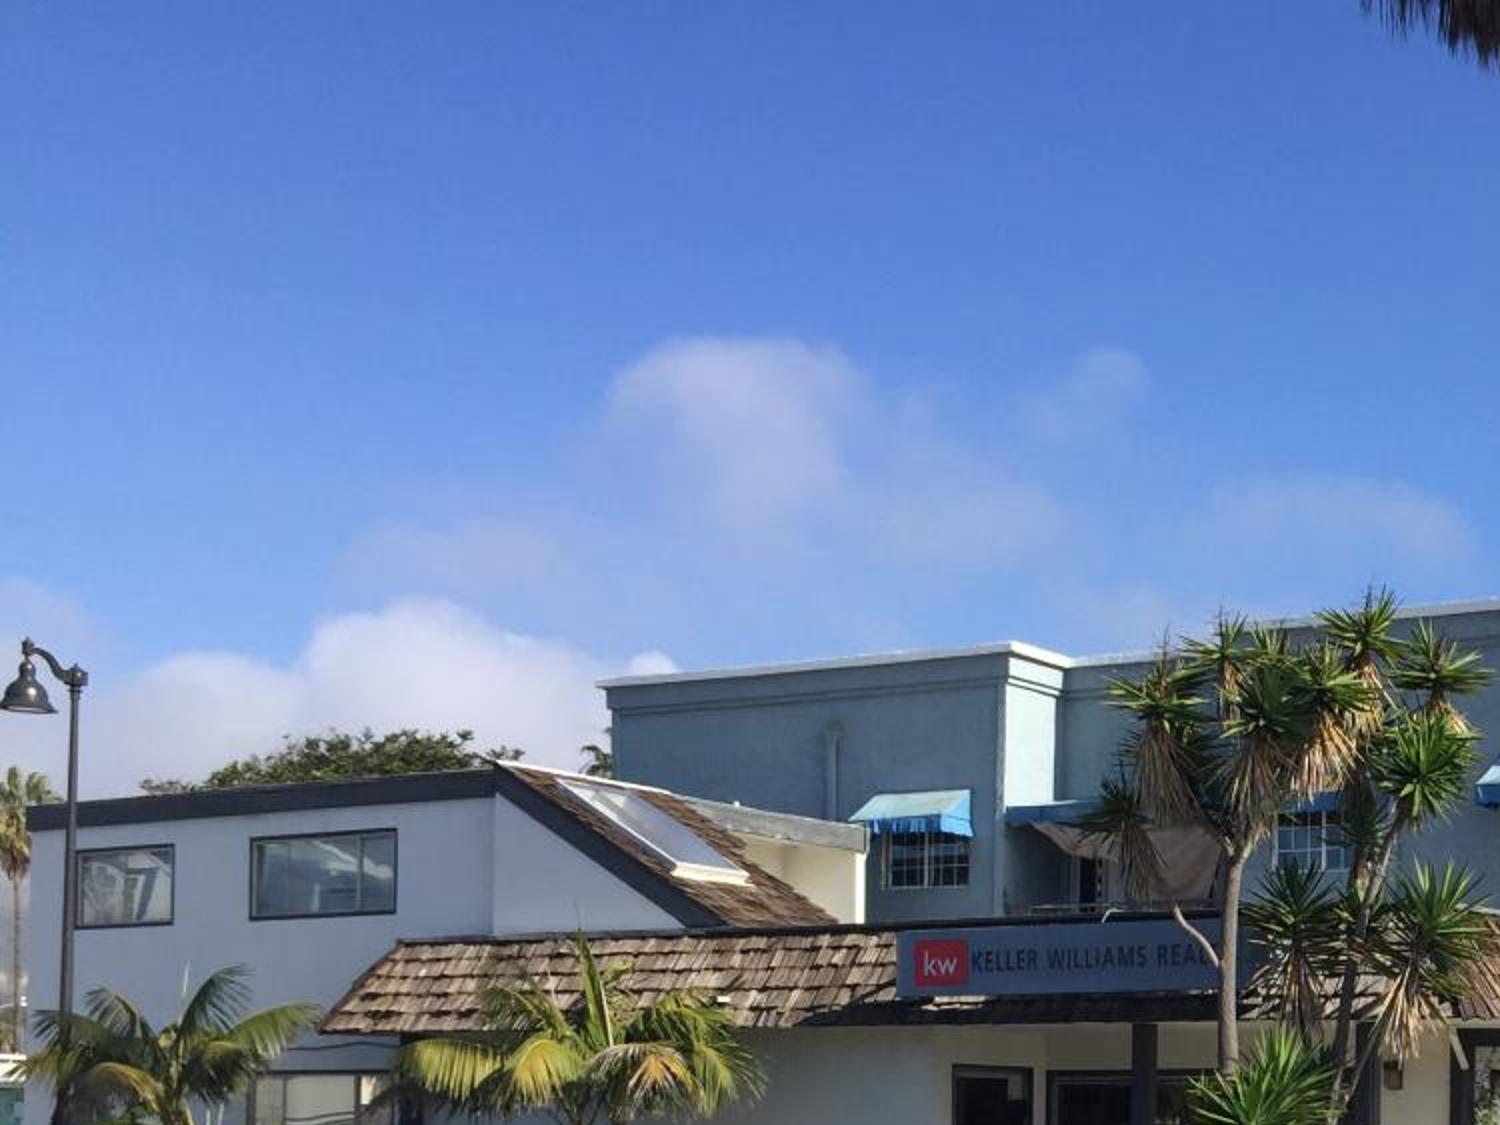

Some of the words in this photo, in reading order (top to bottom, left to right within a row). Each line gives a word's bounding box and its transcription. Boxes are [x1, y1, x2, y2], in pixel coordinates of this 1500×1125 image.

[923, 951, 958, 976] kw
[970, 949, 1037, 974] KELLER
[1047, 946, 1149, 970] WILLIAMS
[1157, 944, 1217, 966] REAL
